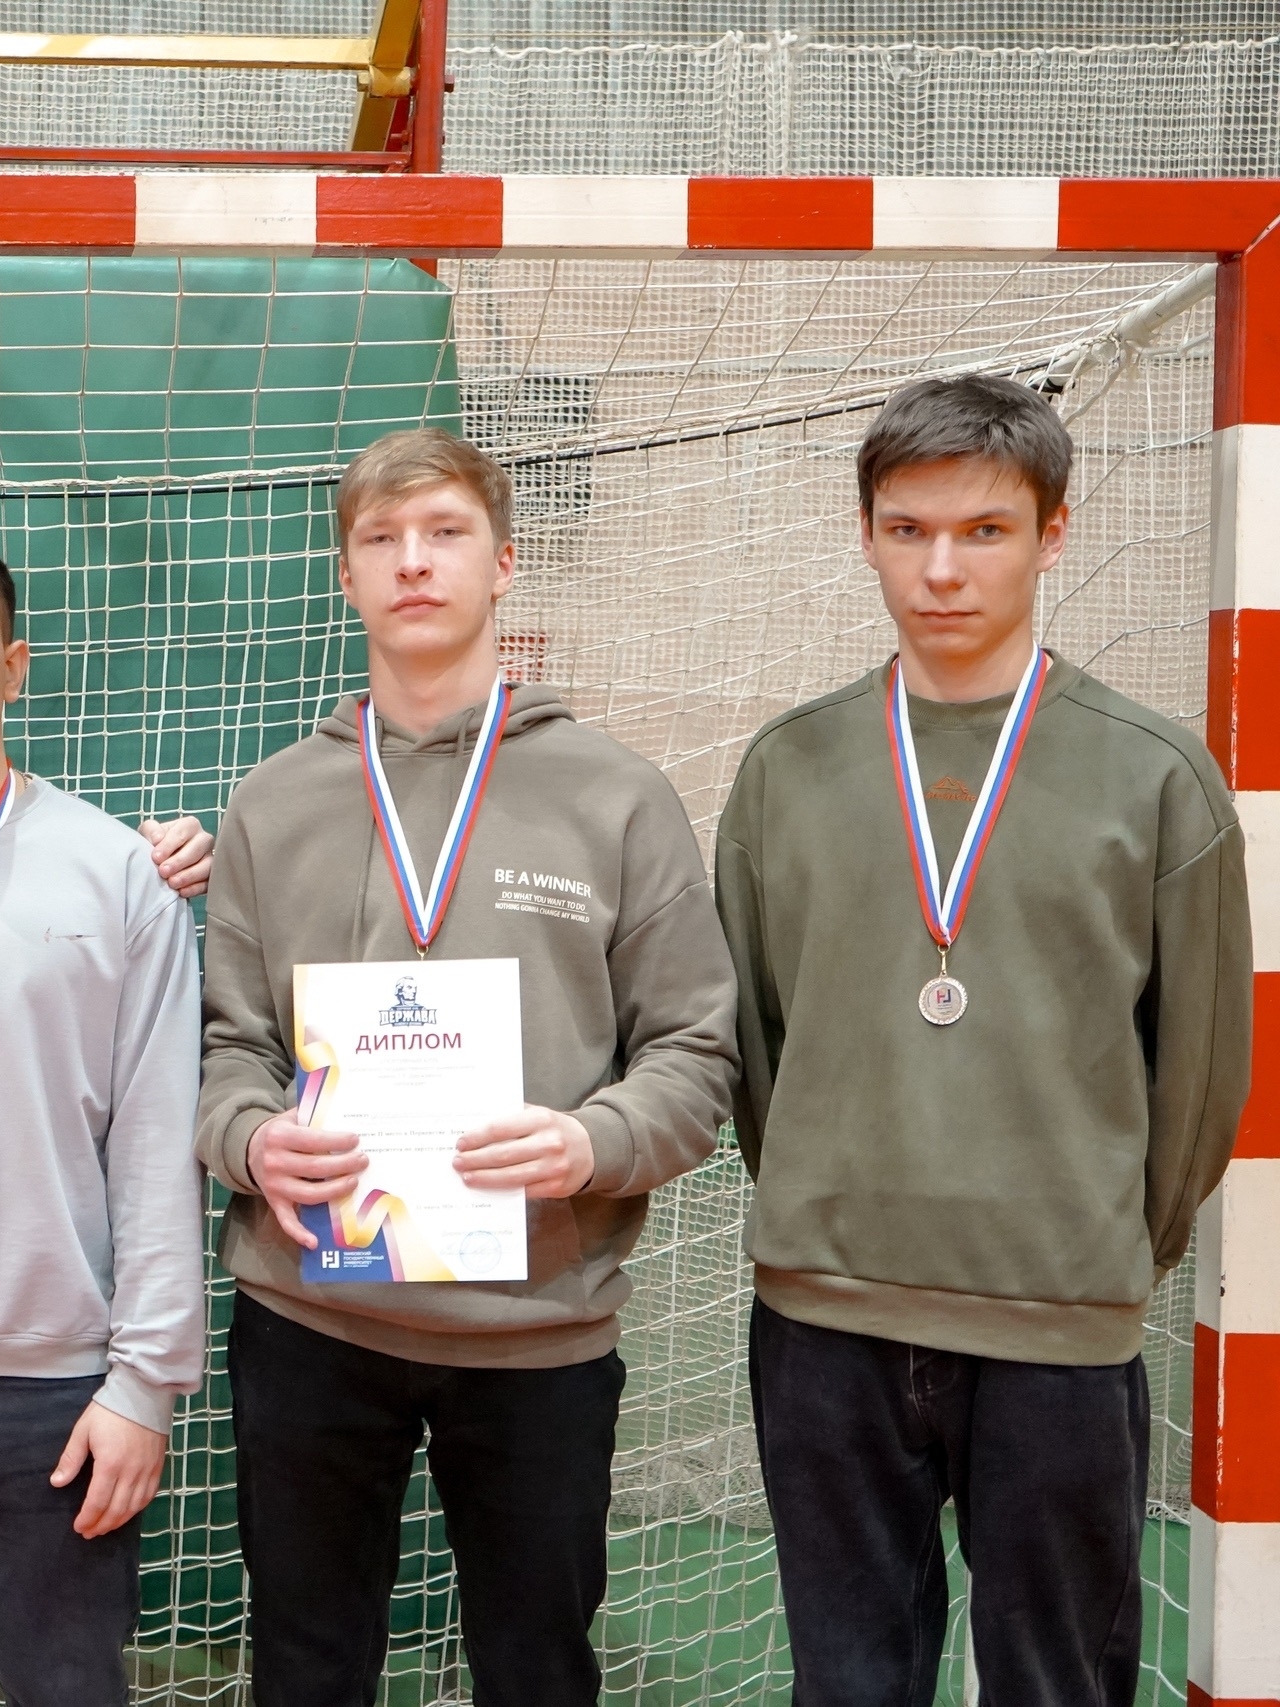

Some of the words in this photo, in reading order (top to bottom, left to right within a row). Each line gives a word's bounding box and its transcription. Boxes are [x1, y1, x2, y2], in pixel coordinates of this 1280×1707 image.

[494, 868, 515, 884] BE
[517, 871, 530, 886] A
[532, 872, 592, 899] WINNER
[501, 891, 513, 899] DO
[513, 892, 533, 901] WHAT
[533, 895, 547, 904] YOU
[547, 897, 567, 907] WANT
[566, 901, 576, 909] TO
[576, 903, 586, 912] DO
[495, 902, 520, 911] NOTHING
[520, 904, 539, 914] GONNA
[540, 907, 560, 918] CHANGE
[560, 911, 570, 919] MY
[570, 914, 590, 923] WORLD
[379, 1009, 437, 1025] ДЕРЖАВА
[355, 1032, 462, 1055] ДИПЛОМ
